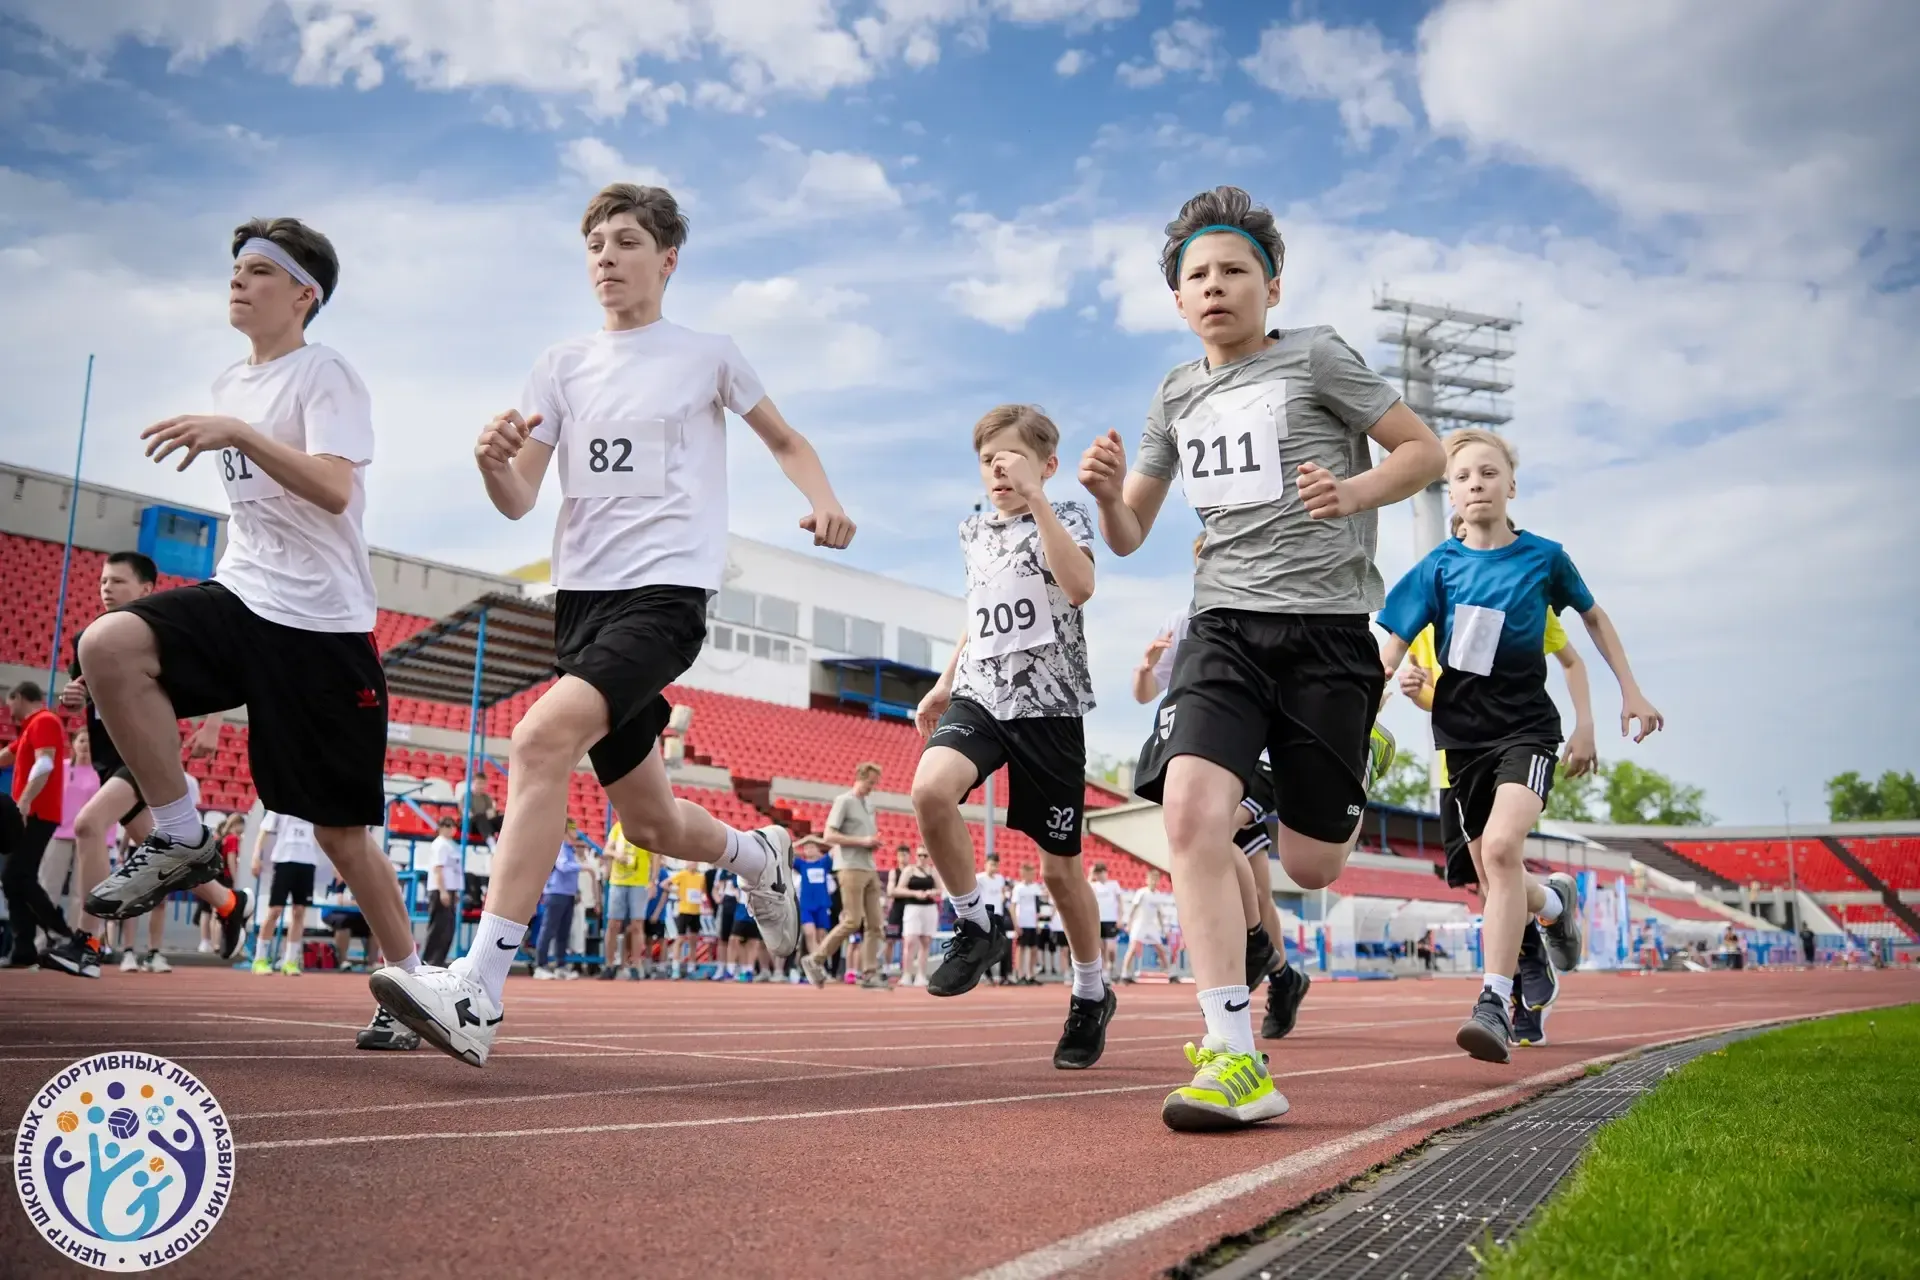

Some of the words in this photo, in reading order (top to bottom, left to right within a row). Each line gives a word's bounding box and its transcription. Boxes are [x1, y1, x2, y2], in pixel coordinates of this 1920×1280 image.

[222, 449, 253, 482] 81
[589, 438, 634, 473] 82
[1187, 431, 1261, 478] 211
[976, 598, 1036, 639] 209
[1046, 805, 1075, 832] 32
[1048, 831, 1068, 841] GS
